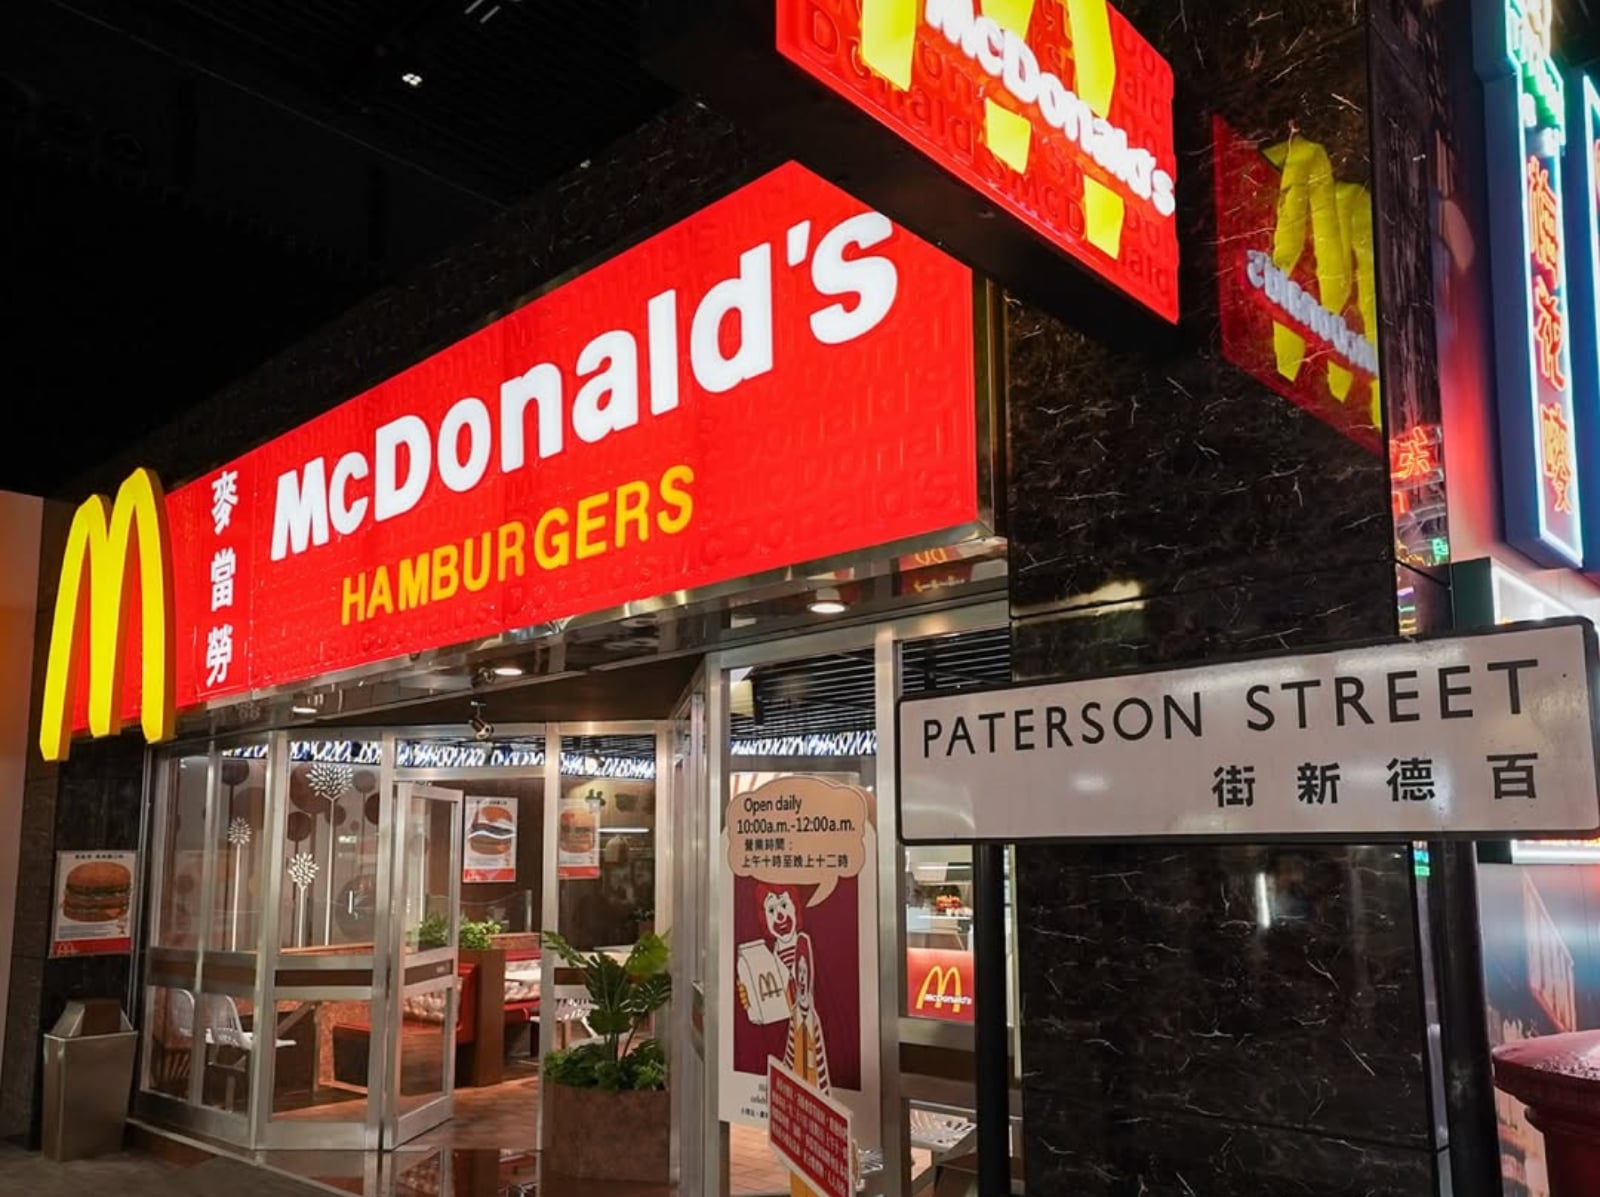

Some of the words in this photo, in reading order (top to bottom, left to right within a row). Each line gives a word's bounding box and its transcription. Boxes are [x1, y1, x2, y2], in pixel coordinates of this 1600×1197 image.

[271, 212, 898, 560] McDonald's
[206, 470, 238, 687] 麥當勞
[341, 465, 694, 625] HAMBURGERS
[923, 692, 1202, 758] PATERSON
[1246, 659, 1539, 732] STREET
[744, 798, 773, 816] Open
[775, 795, 802, 815] daily
